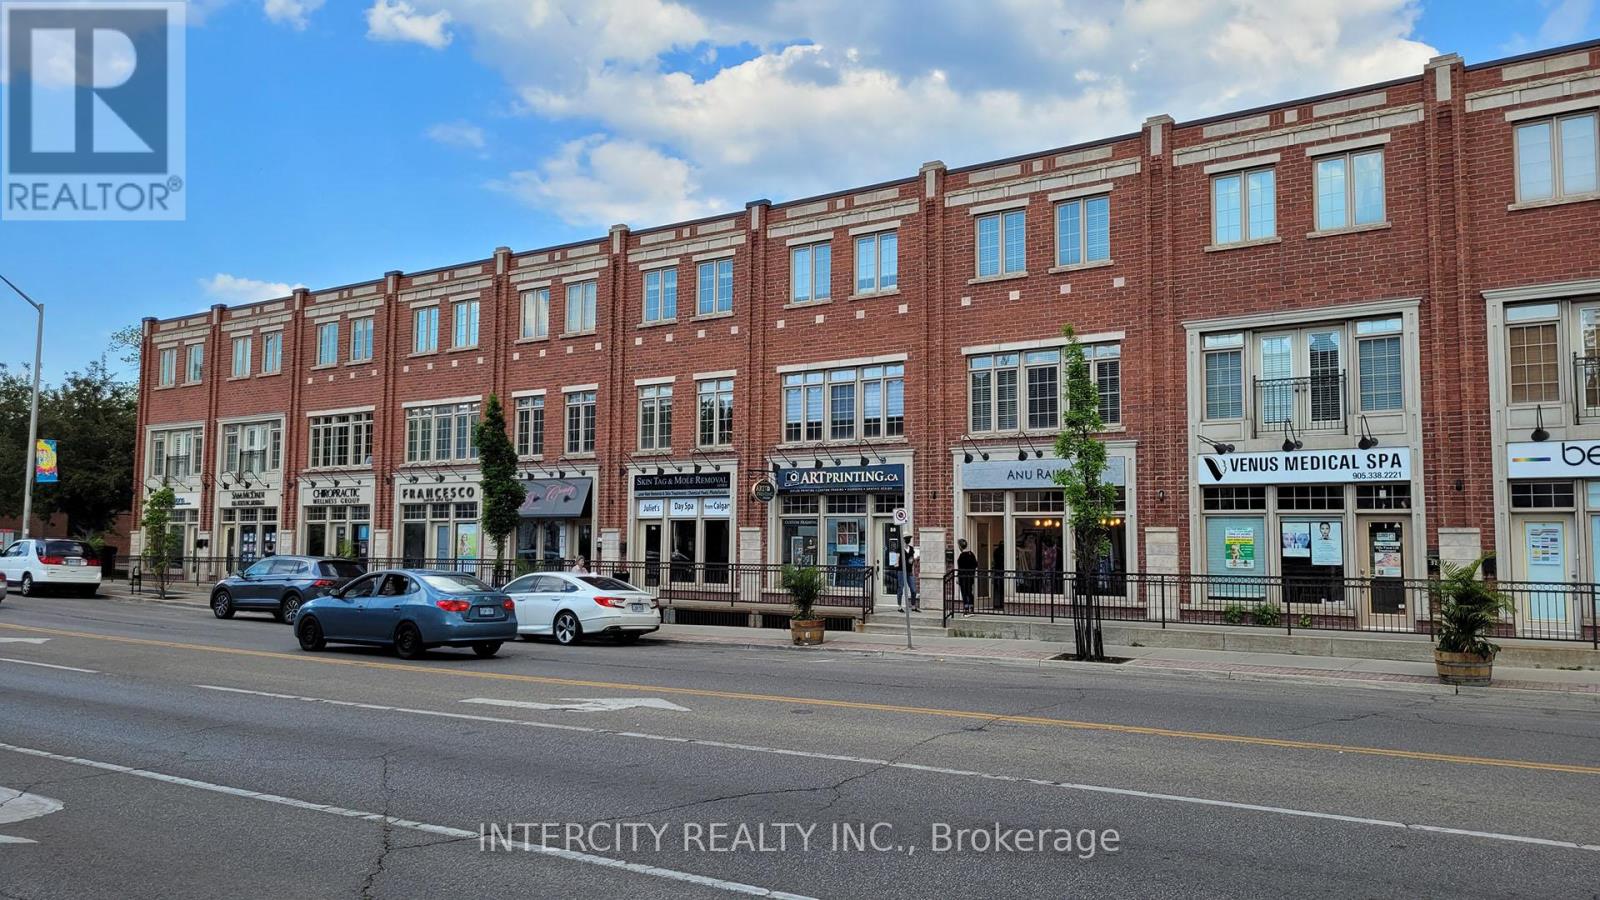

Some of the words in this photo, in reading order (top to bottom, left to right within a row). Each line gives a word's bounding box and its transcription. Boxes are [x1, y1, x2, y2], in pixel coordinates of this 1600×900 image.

[1230, 456, 1278, 472] VENUS
[1284, 454, 1360, 471] MEDICAL
[1366, 453, 1402, 469] SPA
[637, 477, 652, 486] SKIN
[653, 476, 667, 486] TAG
[674, 475, 694, 485] MOLE
[695, 474, 728, 484] REMOVAL
[1007, 469, 1032, 481] ANU
[1352, 471, 1402, 480] 905.338.2221
[313, 488, 361, 498] CHIROPRACTIC
[403, 487, 475, 499] FRANCESCO
[674, 502, 684, 511] Day
[685, 502, 694, 510] Spa
